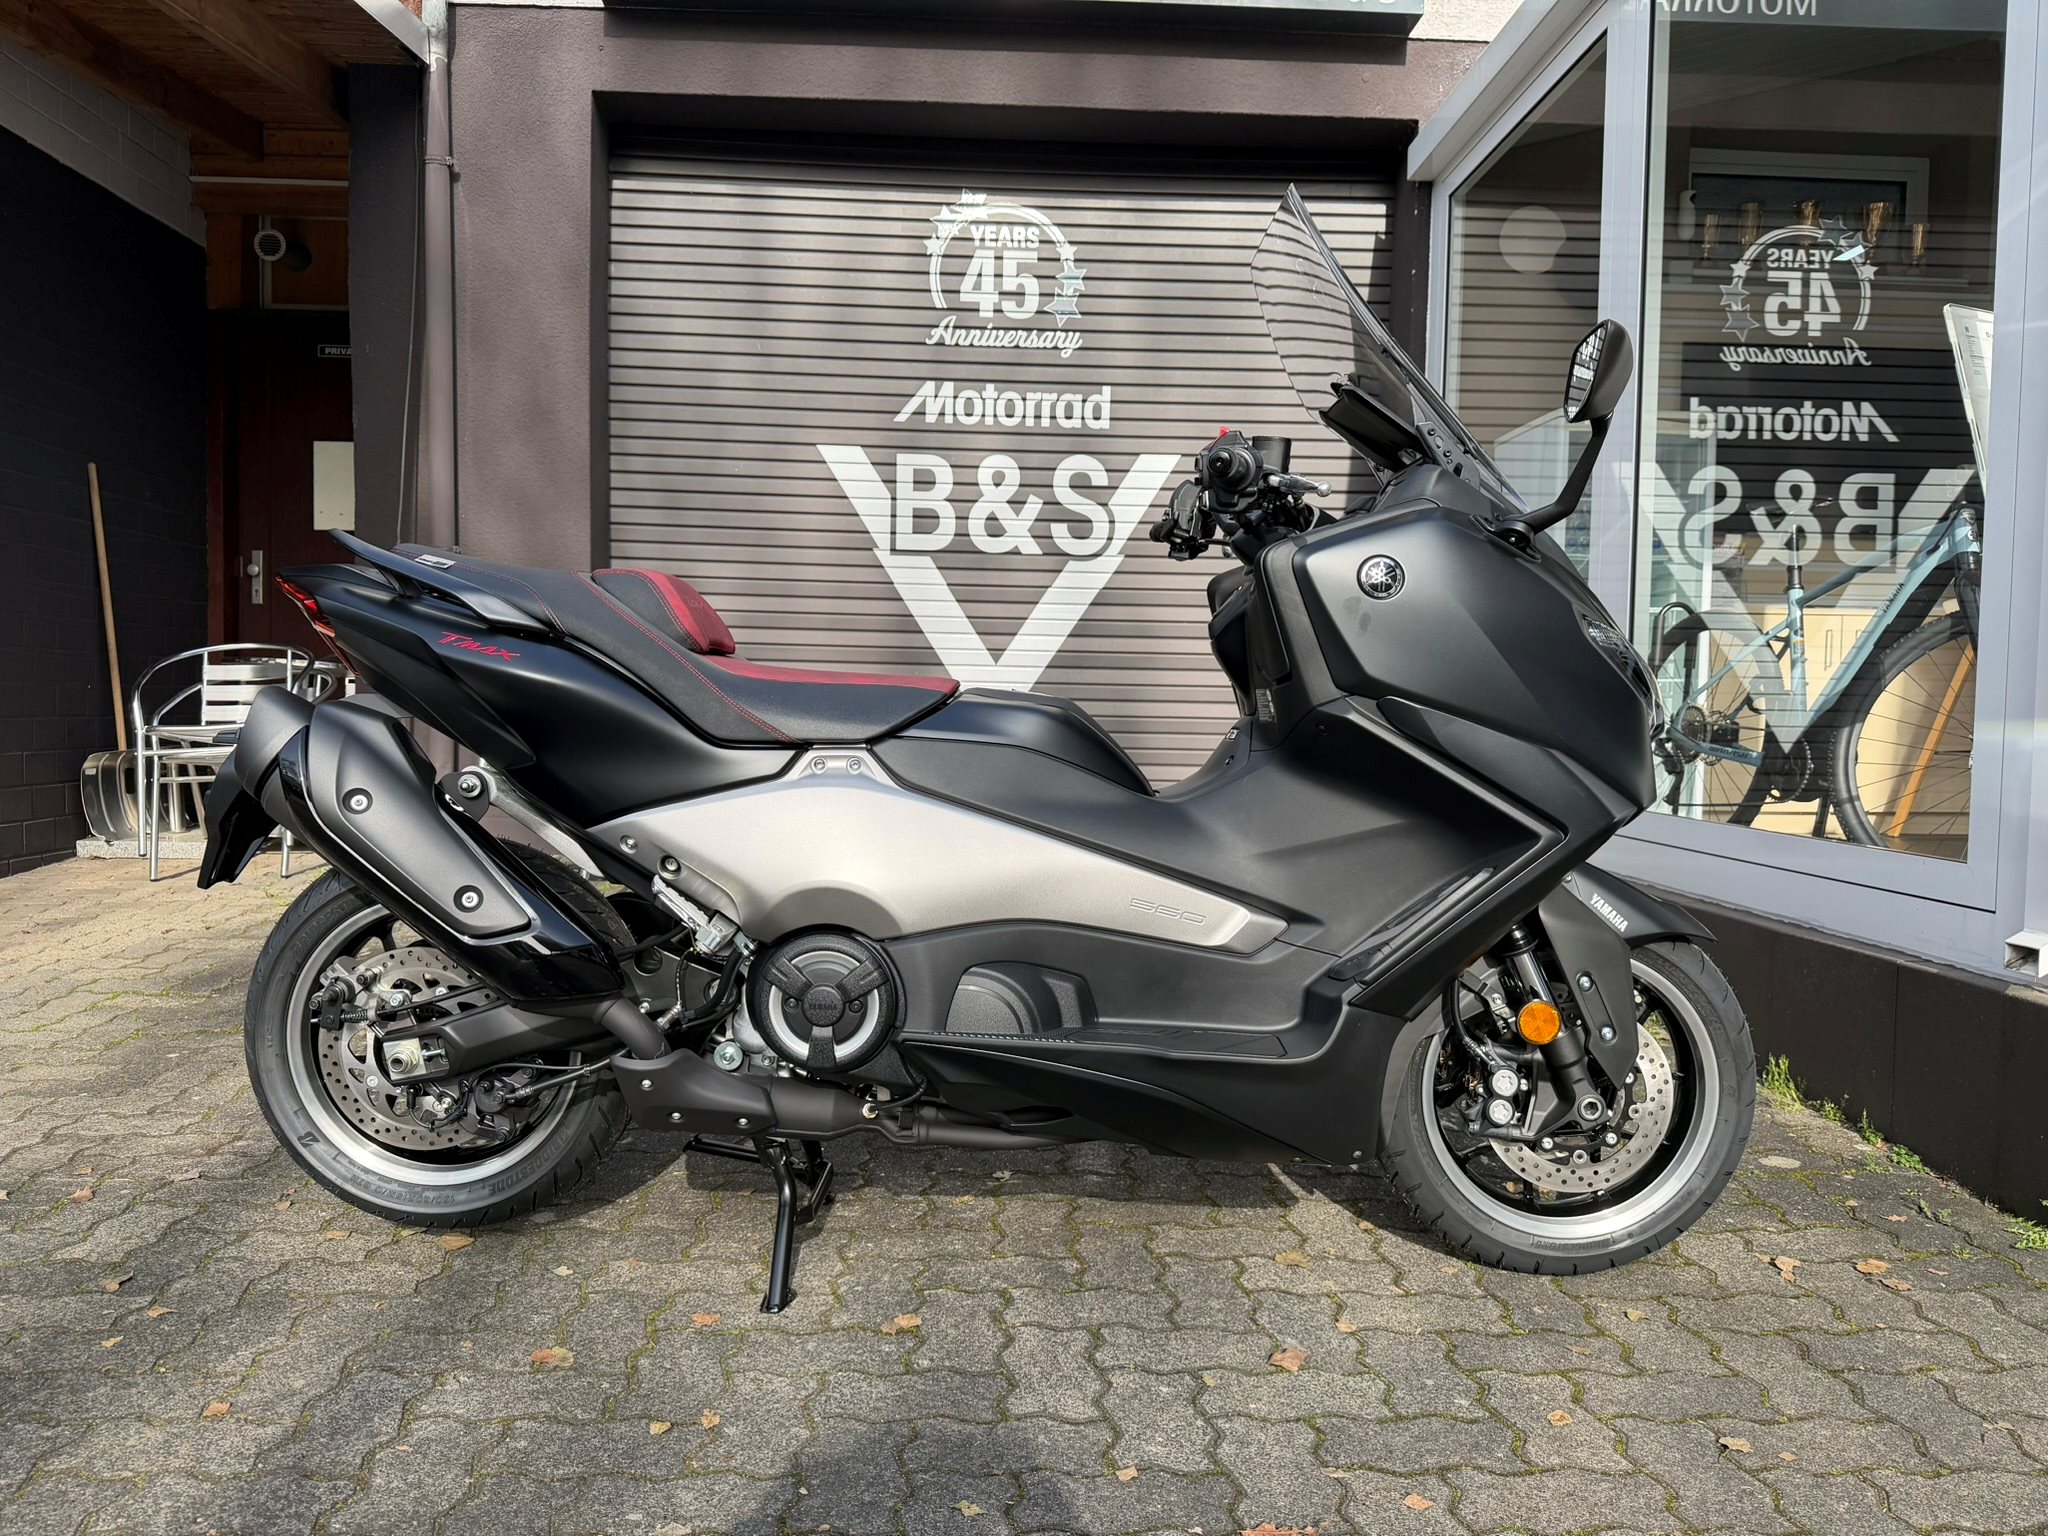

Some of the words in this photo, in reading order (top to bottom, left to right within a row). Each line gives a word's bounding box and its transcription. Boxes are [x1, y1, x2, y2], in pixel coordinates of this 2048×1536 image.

[970, 225, 1040, 248] YEARS
[959, 249, 1040, 320] 45
[925, 315, 1083, 358] Anniversary
[893, 380, 1112, 430] Motorrad
[895, 453, 1111, 556] B&S
[1590, 891, 1629, 932] YAMAHA
